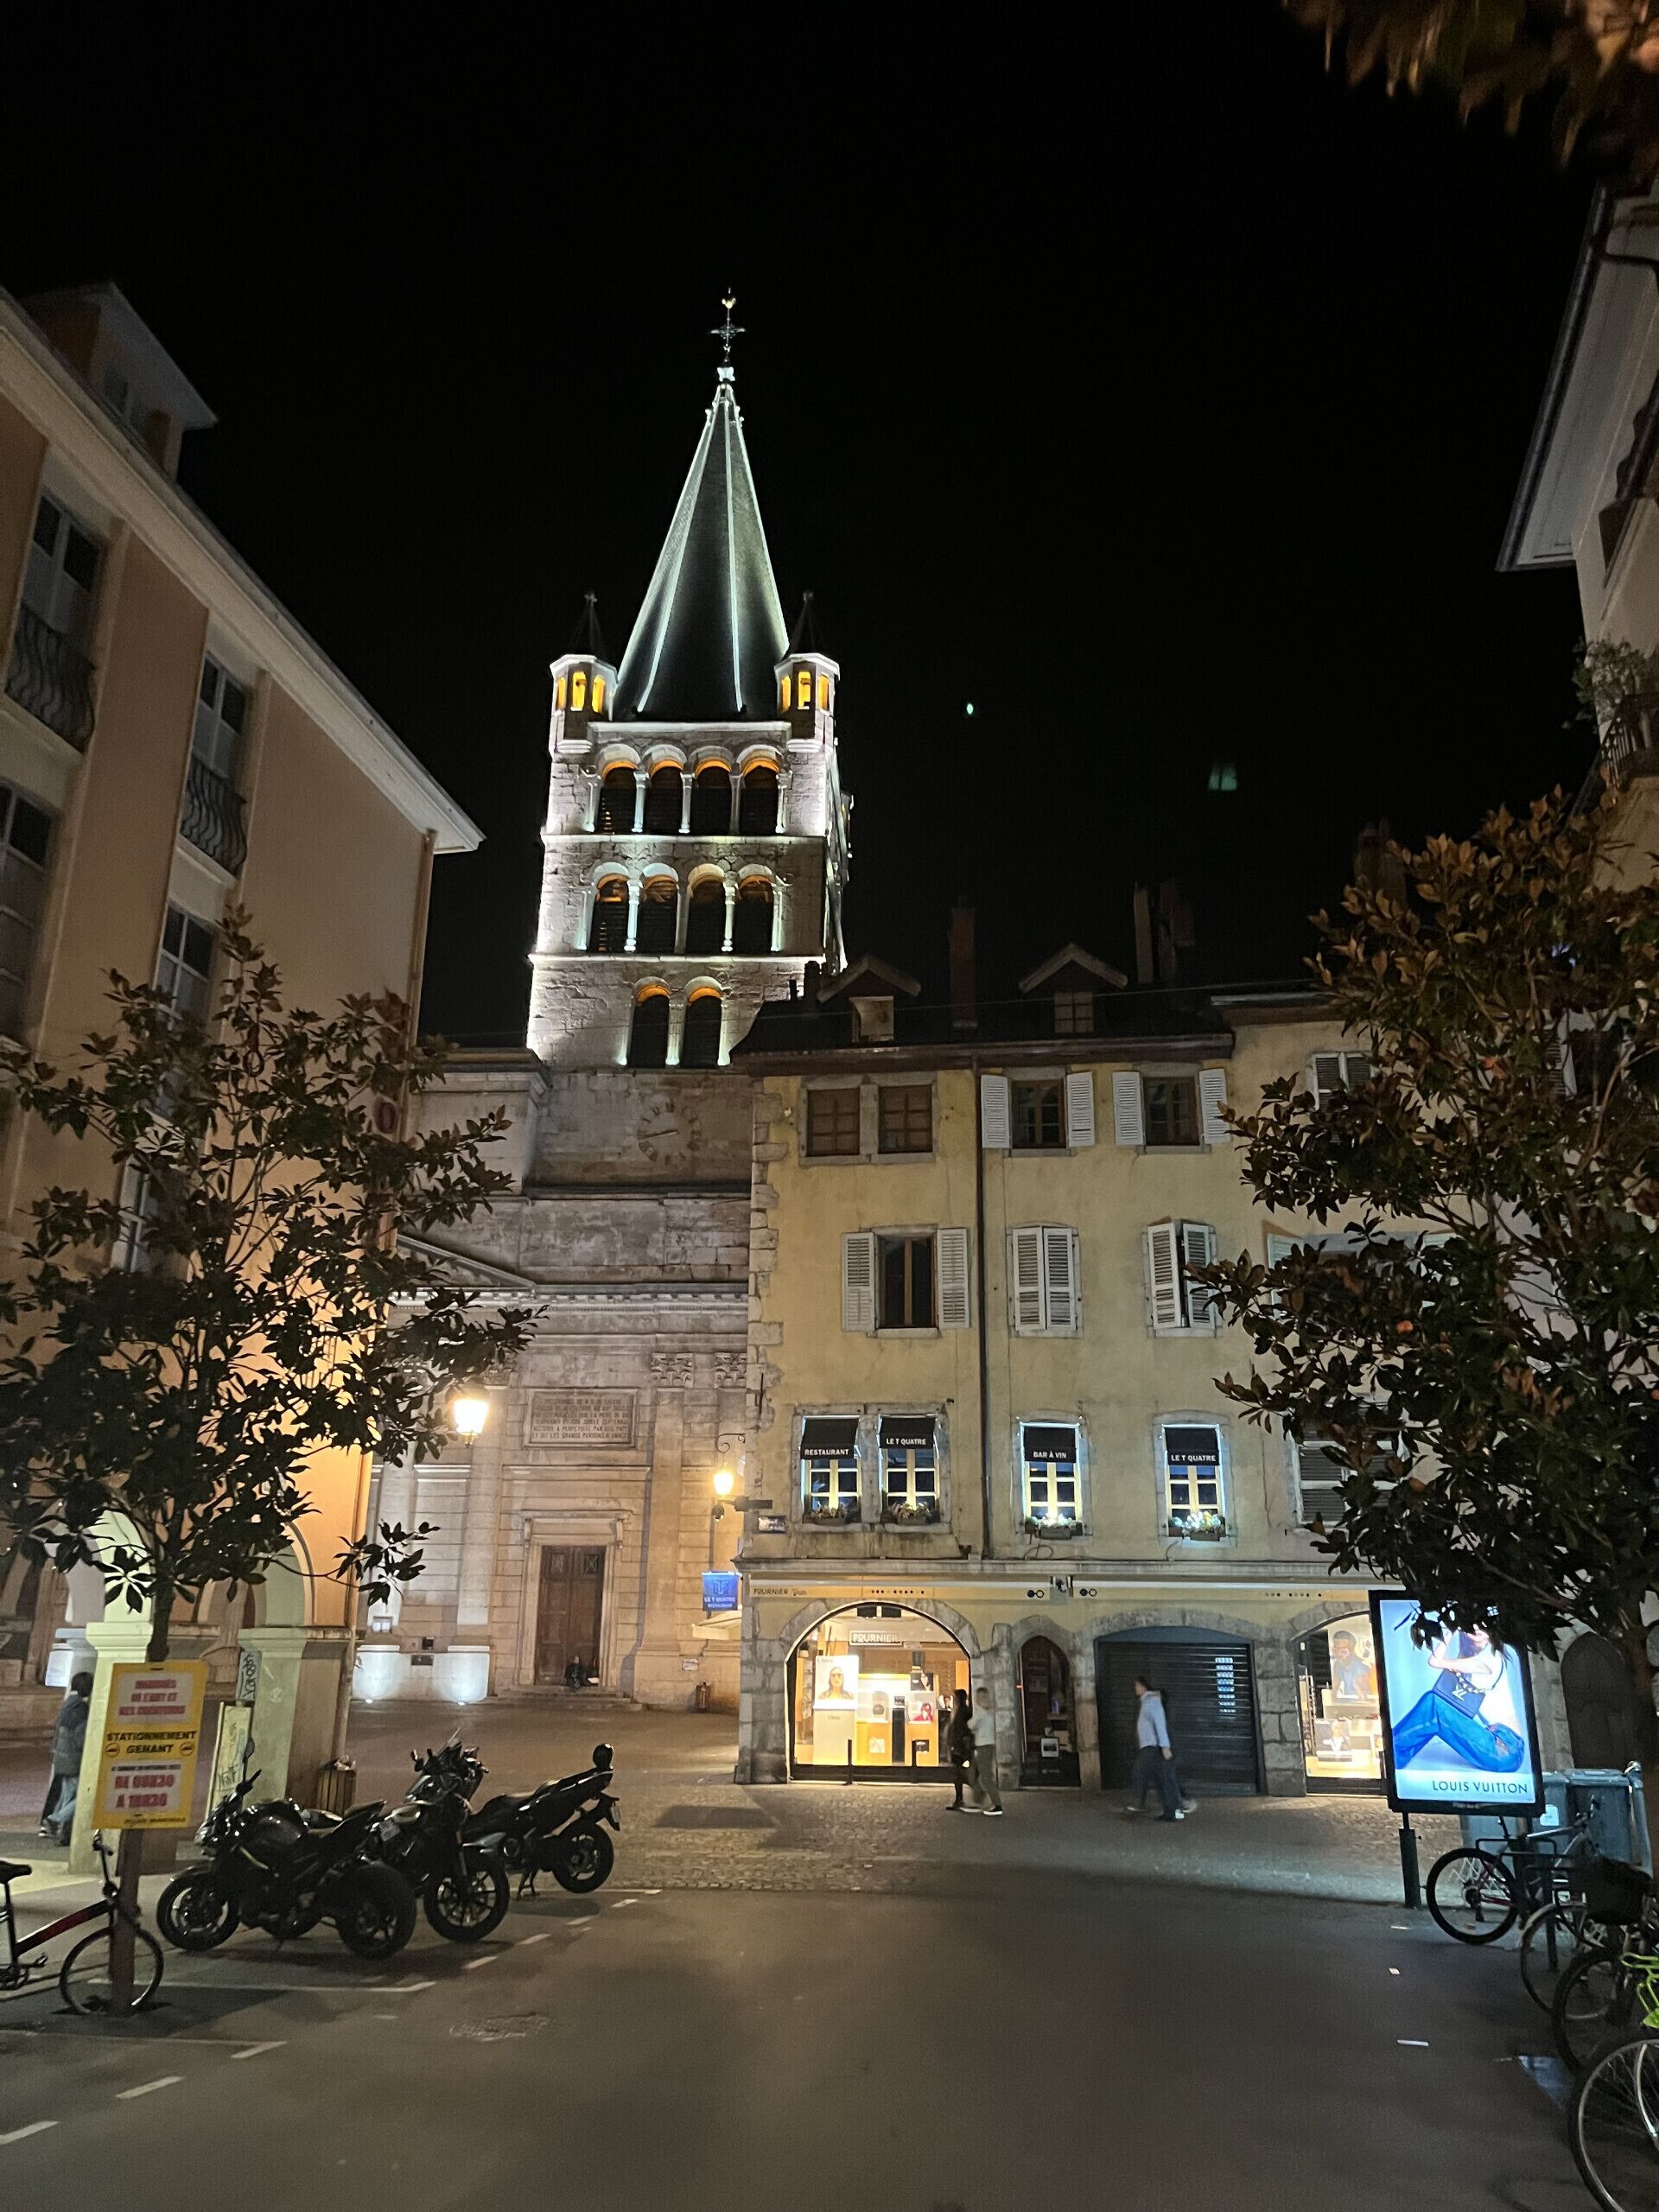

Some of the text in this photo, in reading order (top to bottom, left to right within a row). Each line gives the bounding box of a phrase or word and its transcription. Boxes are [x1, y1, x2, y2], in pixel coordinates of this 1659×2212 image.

[106, 1731, 197, 1741] STATIONNEMENT
[1433, 1780, 1528, 1794] LOUIS VUITTON
